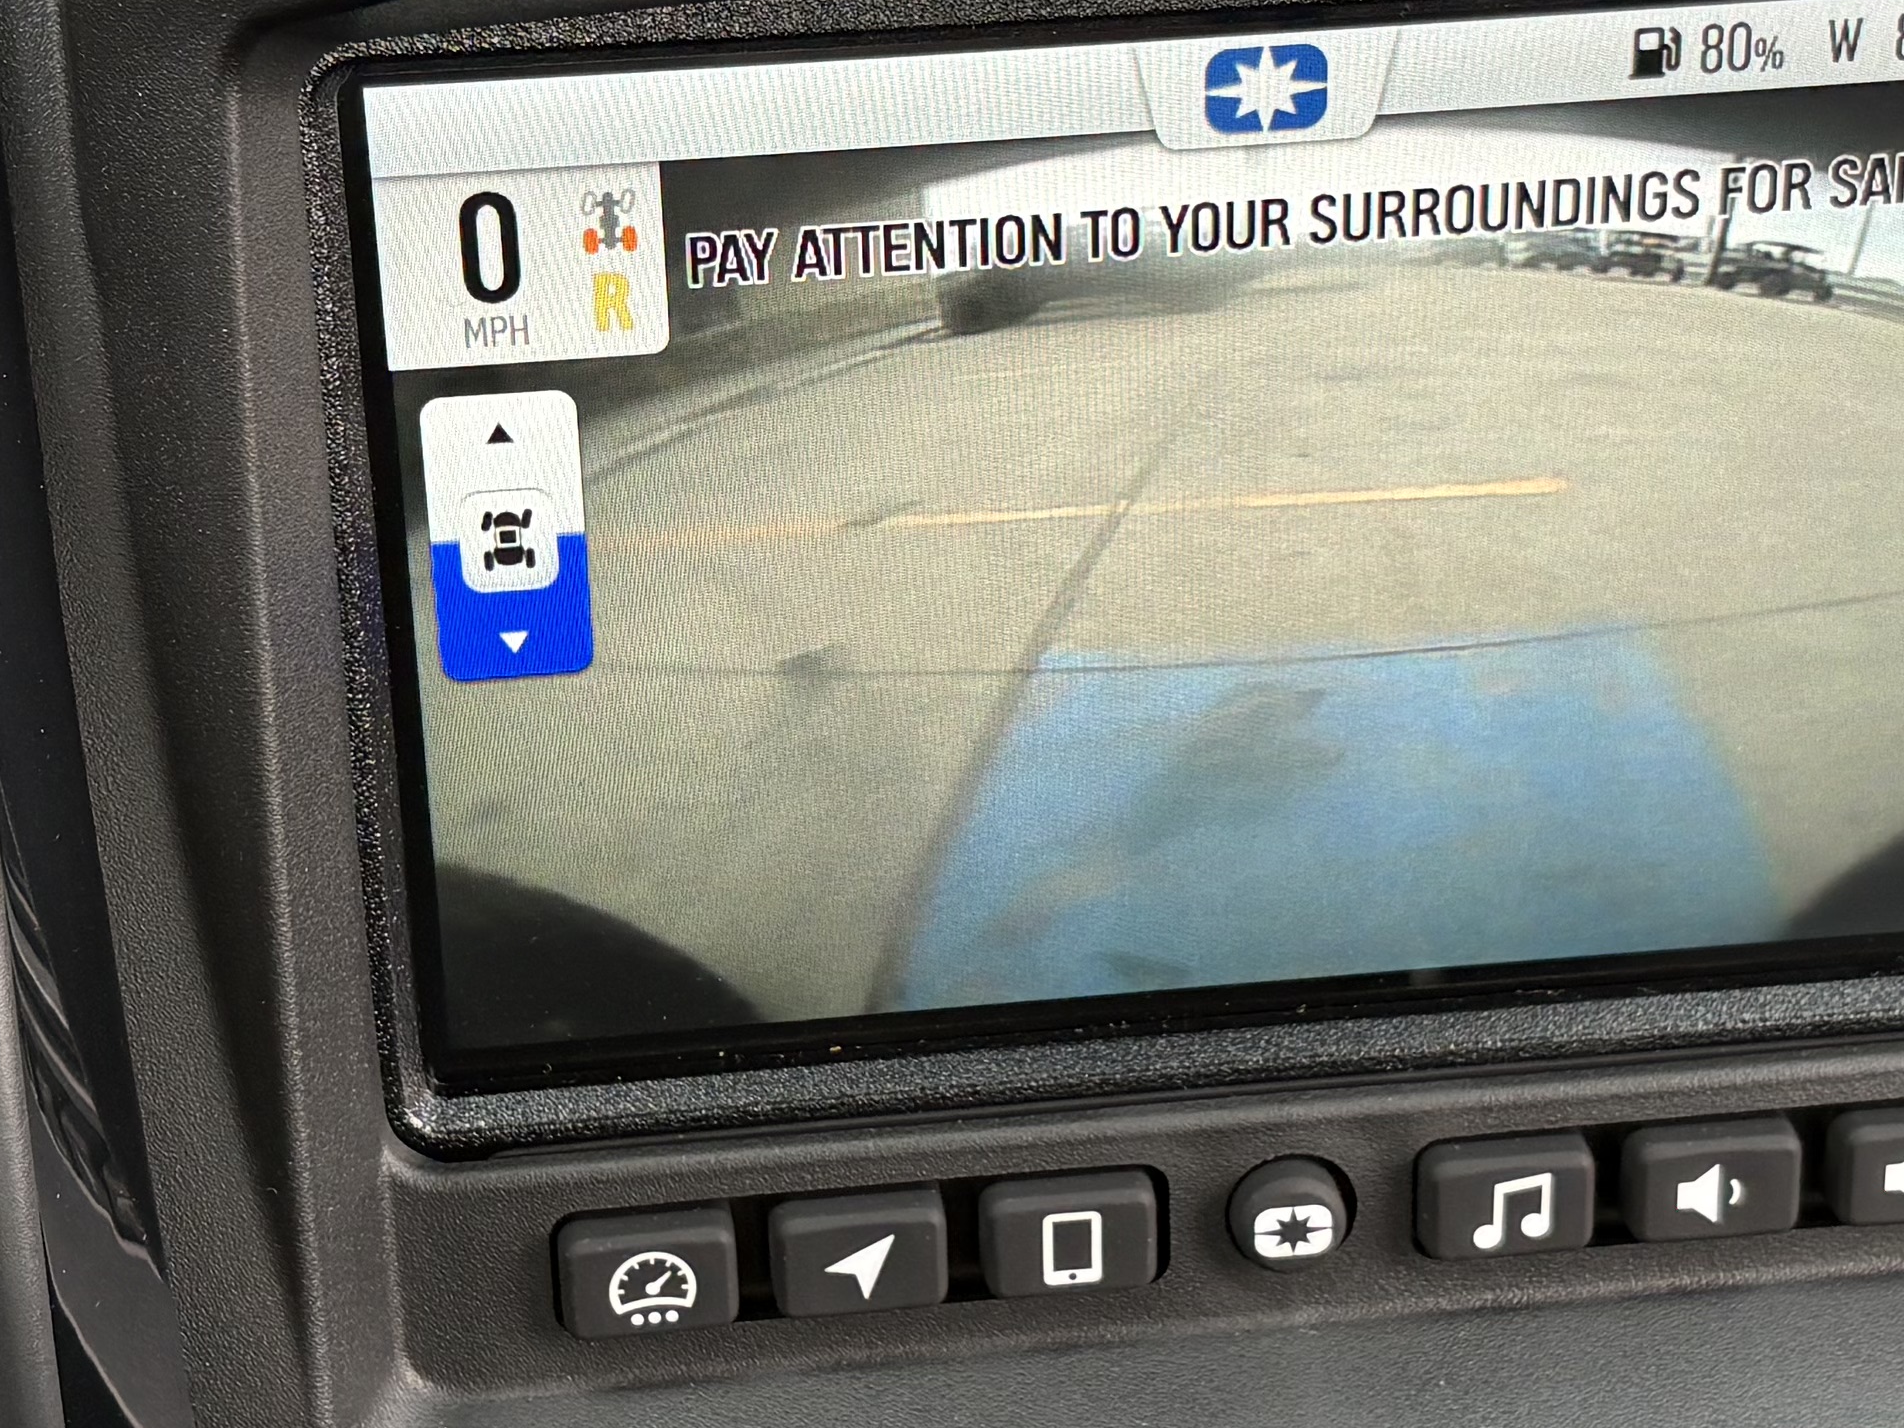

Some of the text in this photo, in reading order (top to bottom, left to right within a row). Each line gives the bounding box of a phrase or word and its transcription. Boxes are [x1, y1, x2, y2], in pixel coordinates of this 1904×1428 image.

[1700, 20, 1785, 74] 80%
[1828, 18, 1864, 63] W
[458, 190, 522, 305] 0
[686, 229, 778, 288] PAY
[792, 211, 1064, 282] ATTENTION
[1080, 205, 1144, 262] TO
[1158, 197, 1292, 256] YOUR
[1308, 167, 1700, 245] SURROUNDINGS
[1716, 158, 1813, 220] FOR
[463, 314, 531, 350] MPH
[591, 272, 635, 333] R
